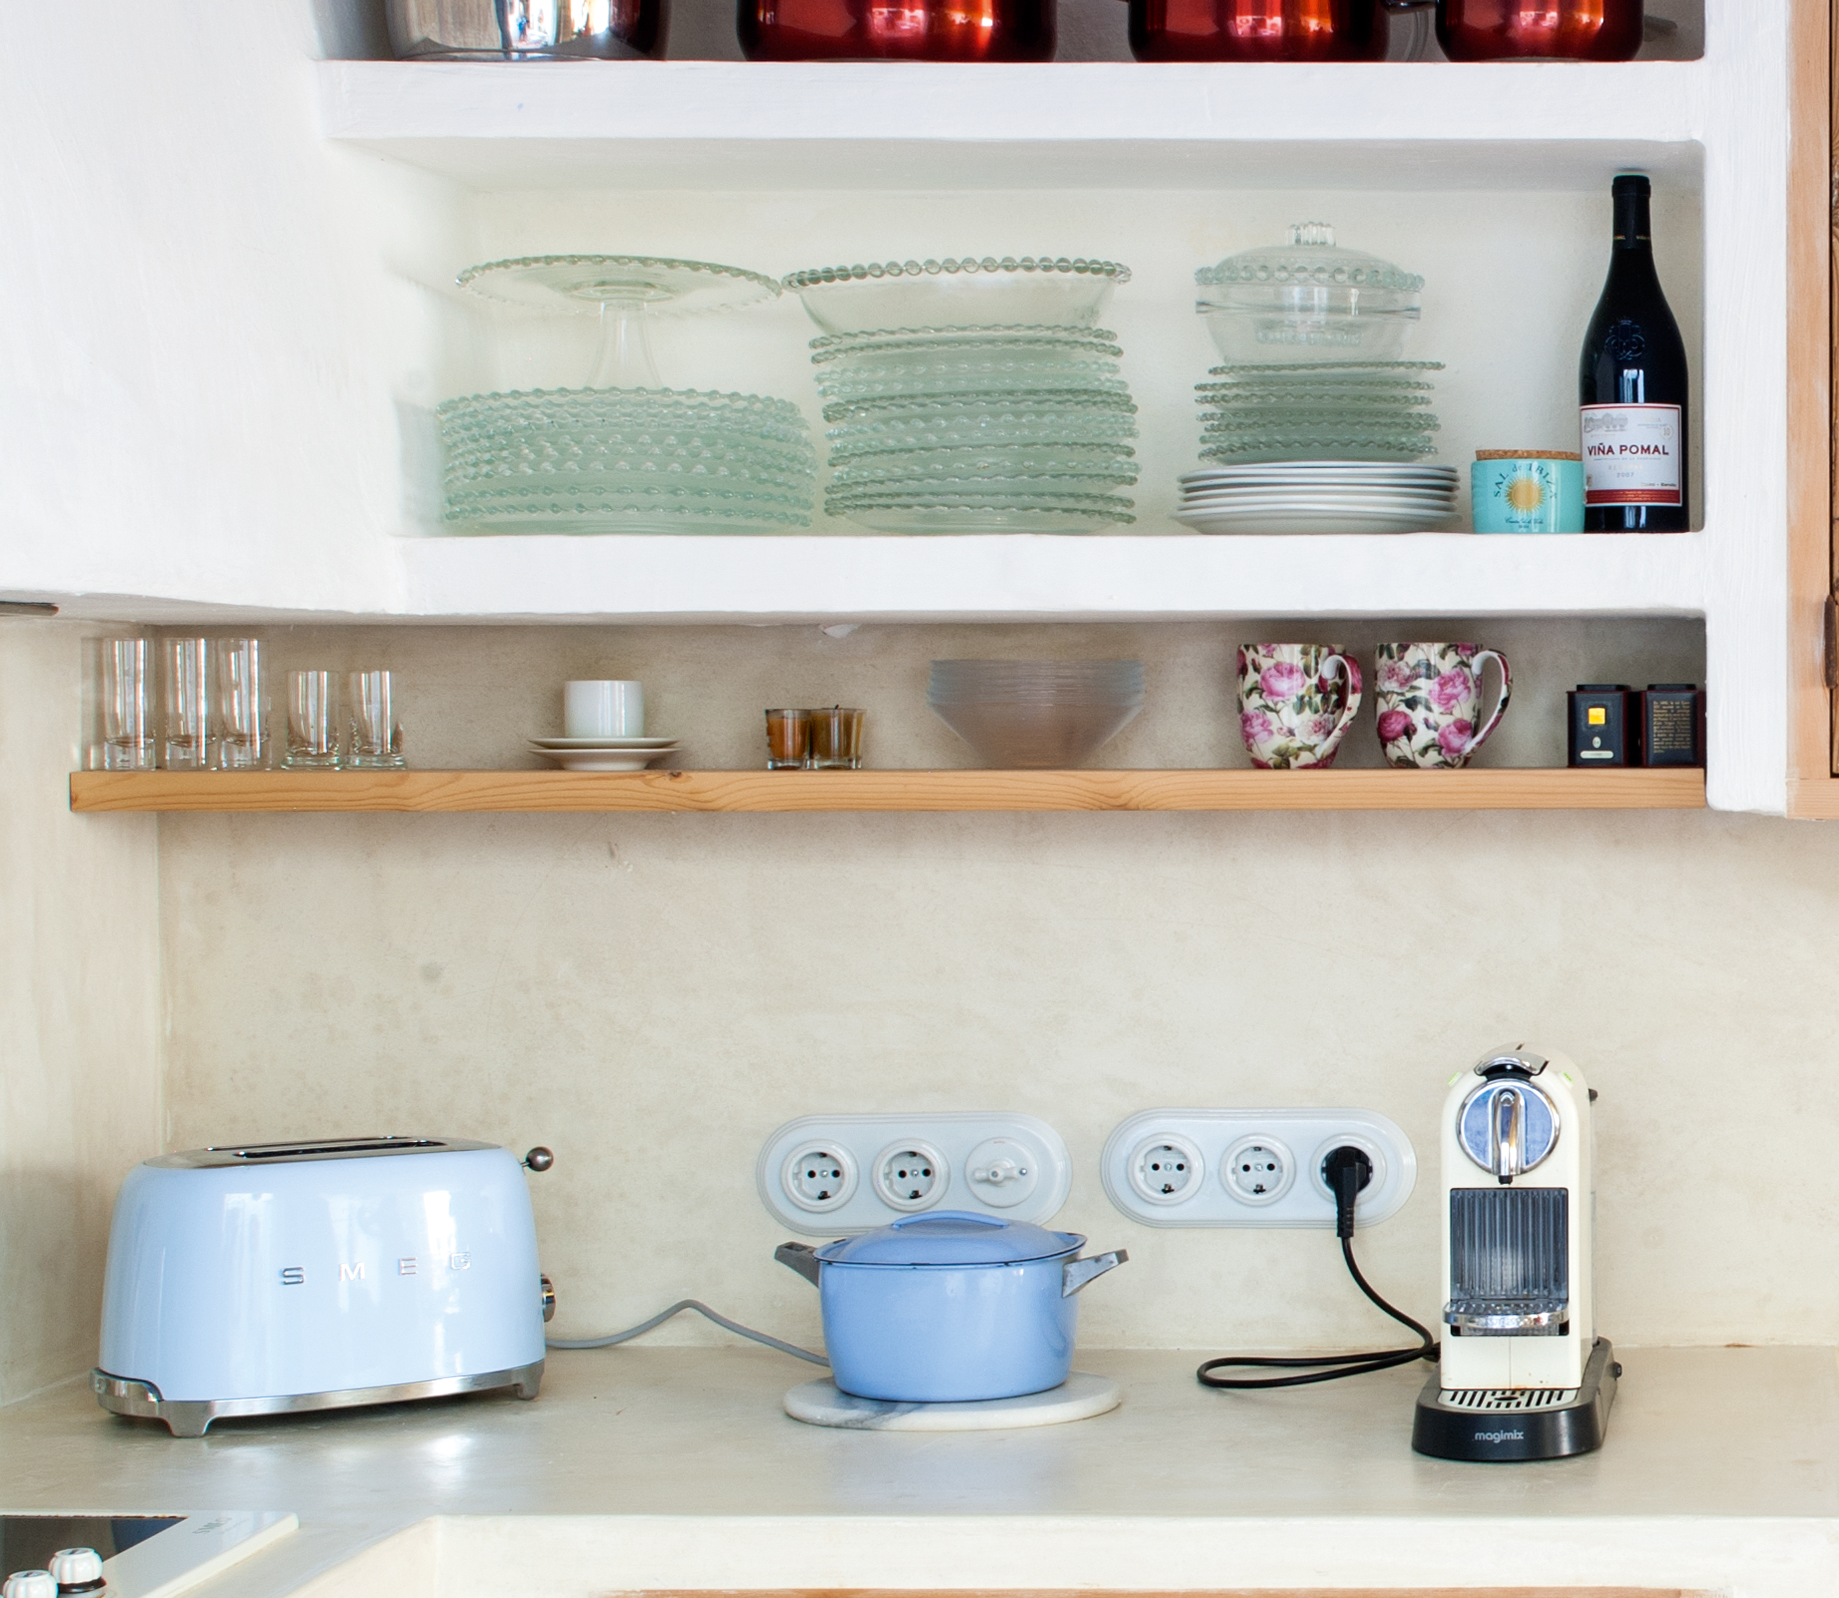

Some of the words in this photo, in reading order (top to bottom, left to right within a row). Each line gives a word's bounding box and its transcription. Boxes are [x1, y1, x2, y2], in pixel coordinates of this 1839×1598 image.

[1587, 442, 1615, 457] VIÑA
[1619, 444, 1670, 457] POMAL
[1493, 472, 1509, 499] SAL
[282, 1252, 471, 1286] SMEG
[1474, 1429, 1525, 1444] magimix
